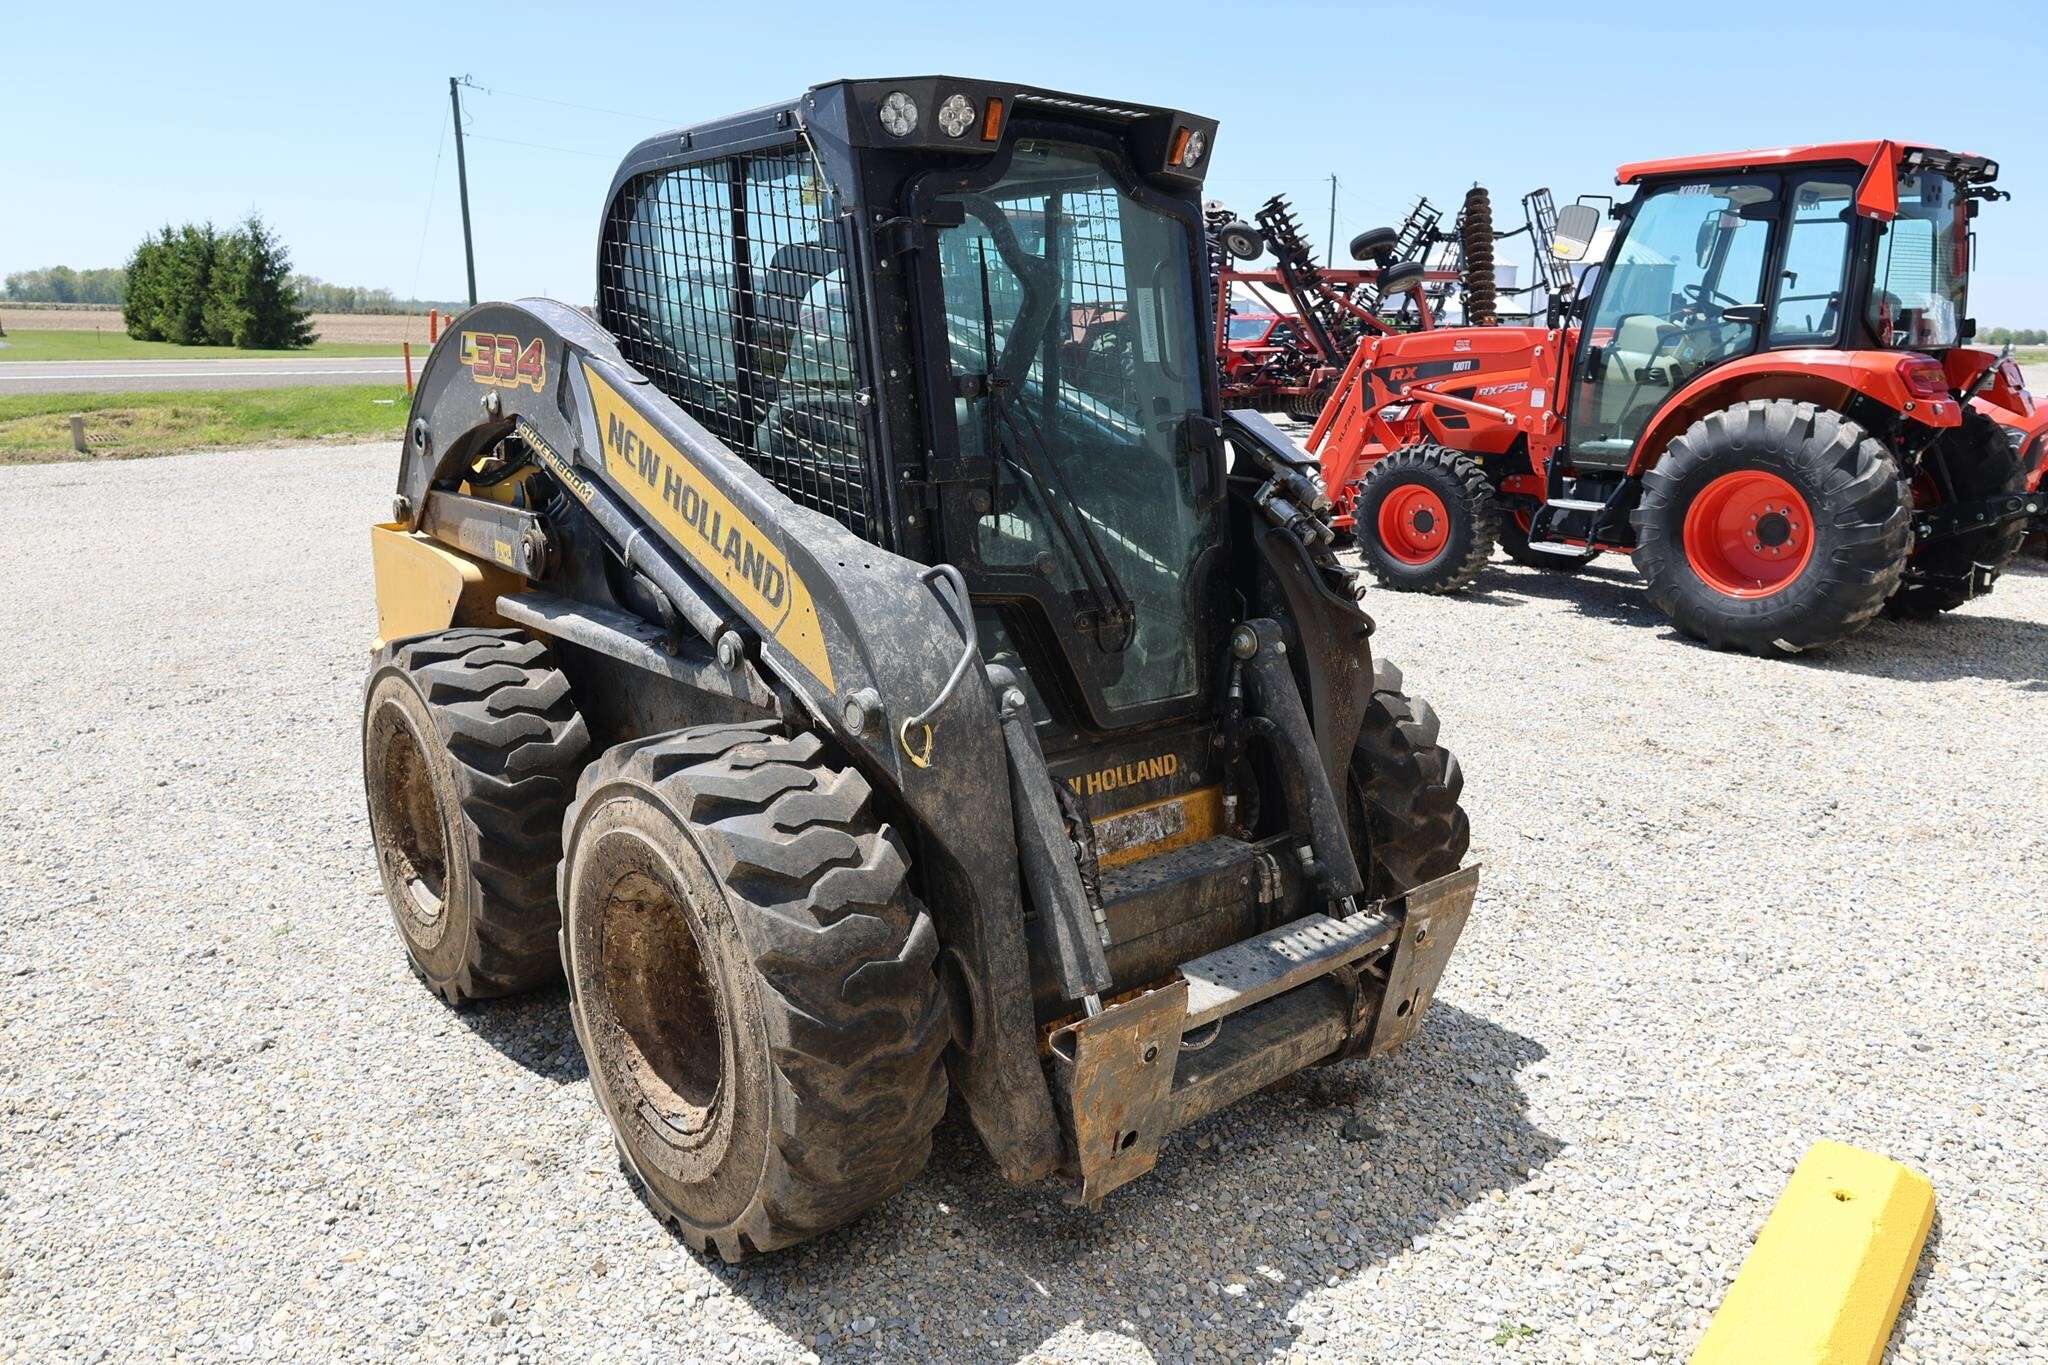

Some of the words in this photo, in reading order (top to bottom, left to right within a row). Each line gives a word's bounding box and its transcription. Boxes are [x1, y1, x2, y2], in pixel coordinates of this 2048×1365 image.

[1679, 184, 1710, 196] KIOTI
[1389, 366, 1418, 381] RX
[1452, 360, 1471, 372] KIOTI
[608, 412, 661, 487] NEW
[663, 465, 785, 608] HOLLAND
[1086, 754, 1178, 795] HOLLAND
